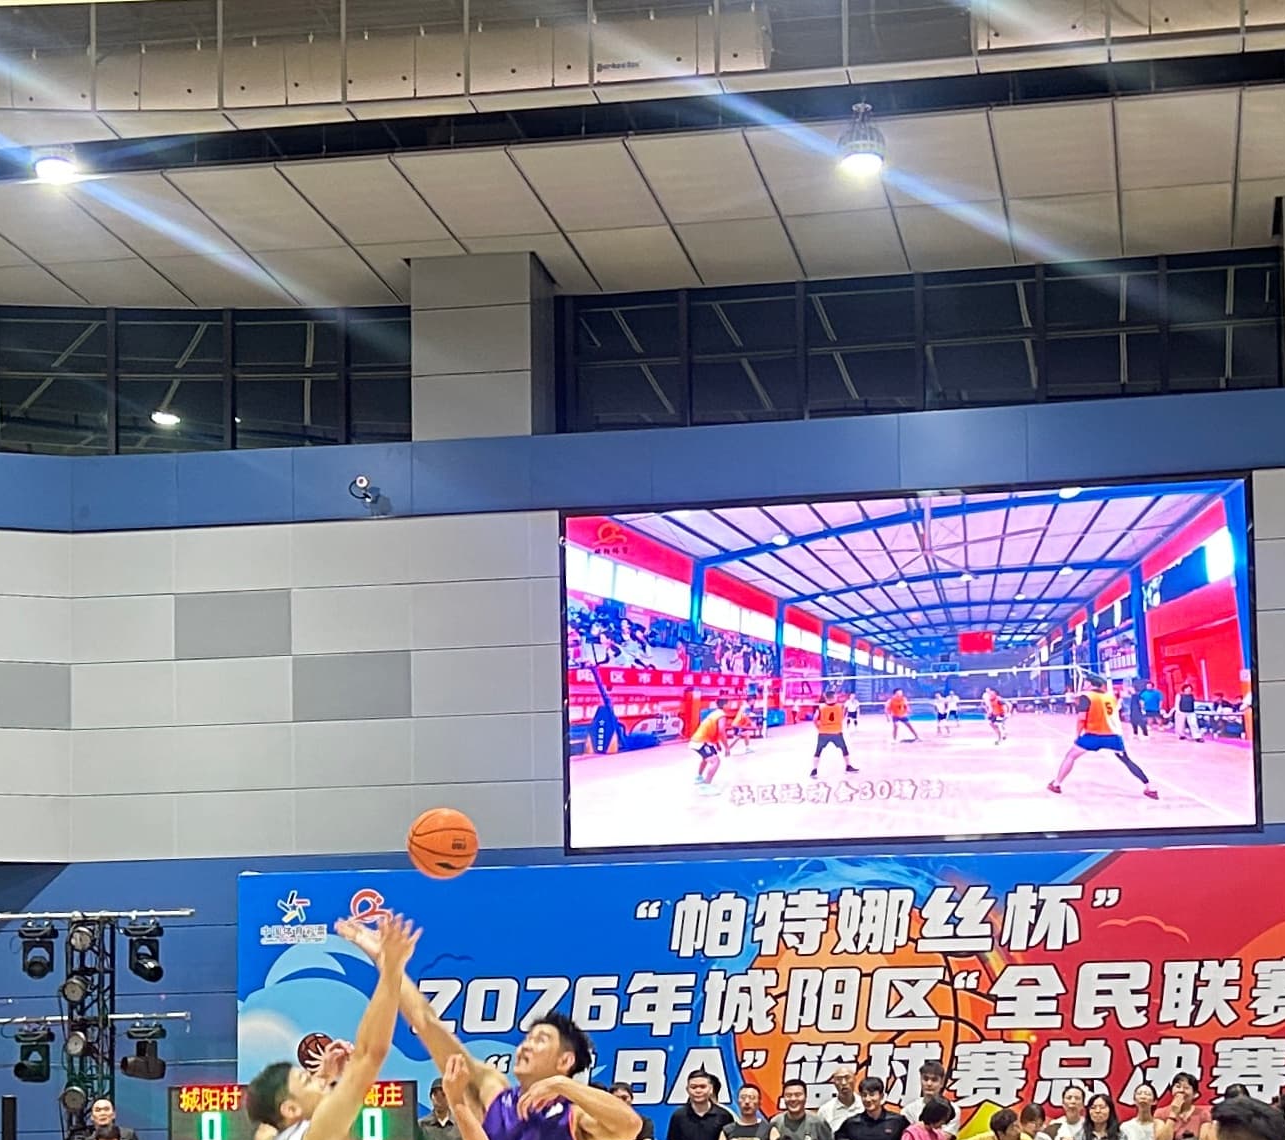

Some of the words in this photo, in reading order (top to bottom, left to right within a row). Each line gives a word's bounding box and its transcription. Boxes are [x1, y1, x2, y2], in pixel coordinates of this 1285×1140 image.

[634, 883, 1122, 957] “帕特娜丝杯”
[180, 1085, 241, 1112] 城阳村
